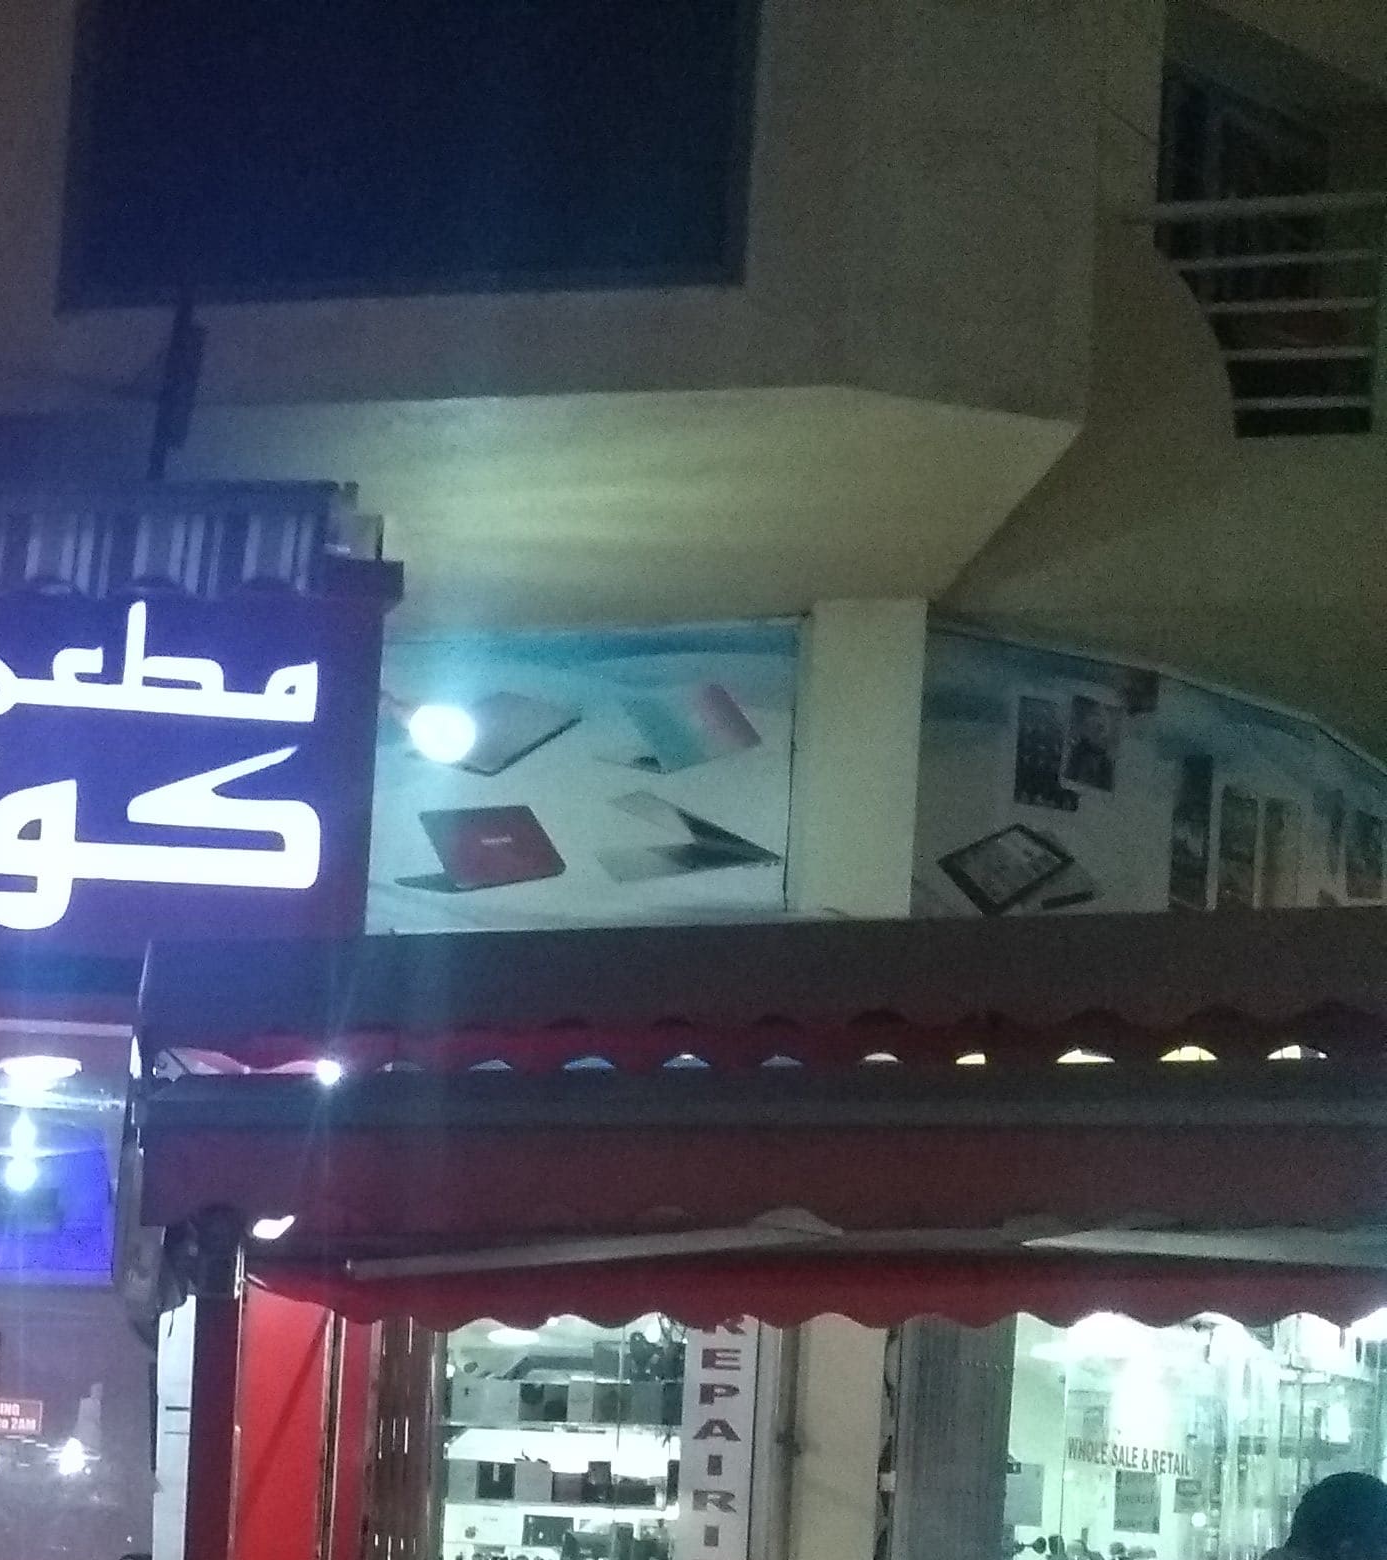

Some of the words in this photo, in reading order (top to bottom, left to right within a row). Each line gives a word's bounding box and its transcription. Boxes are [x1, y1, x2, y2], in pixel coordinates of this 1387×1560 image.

[1068, 1437, 1109, 1467] WHOLE
[1111, 1442, 1139, 1470] SALE
[1141, 1448, 1149, 1468] &
[1152, 1449, 1192, 1476] RETAIL
